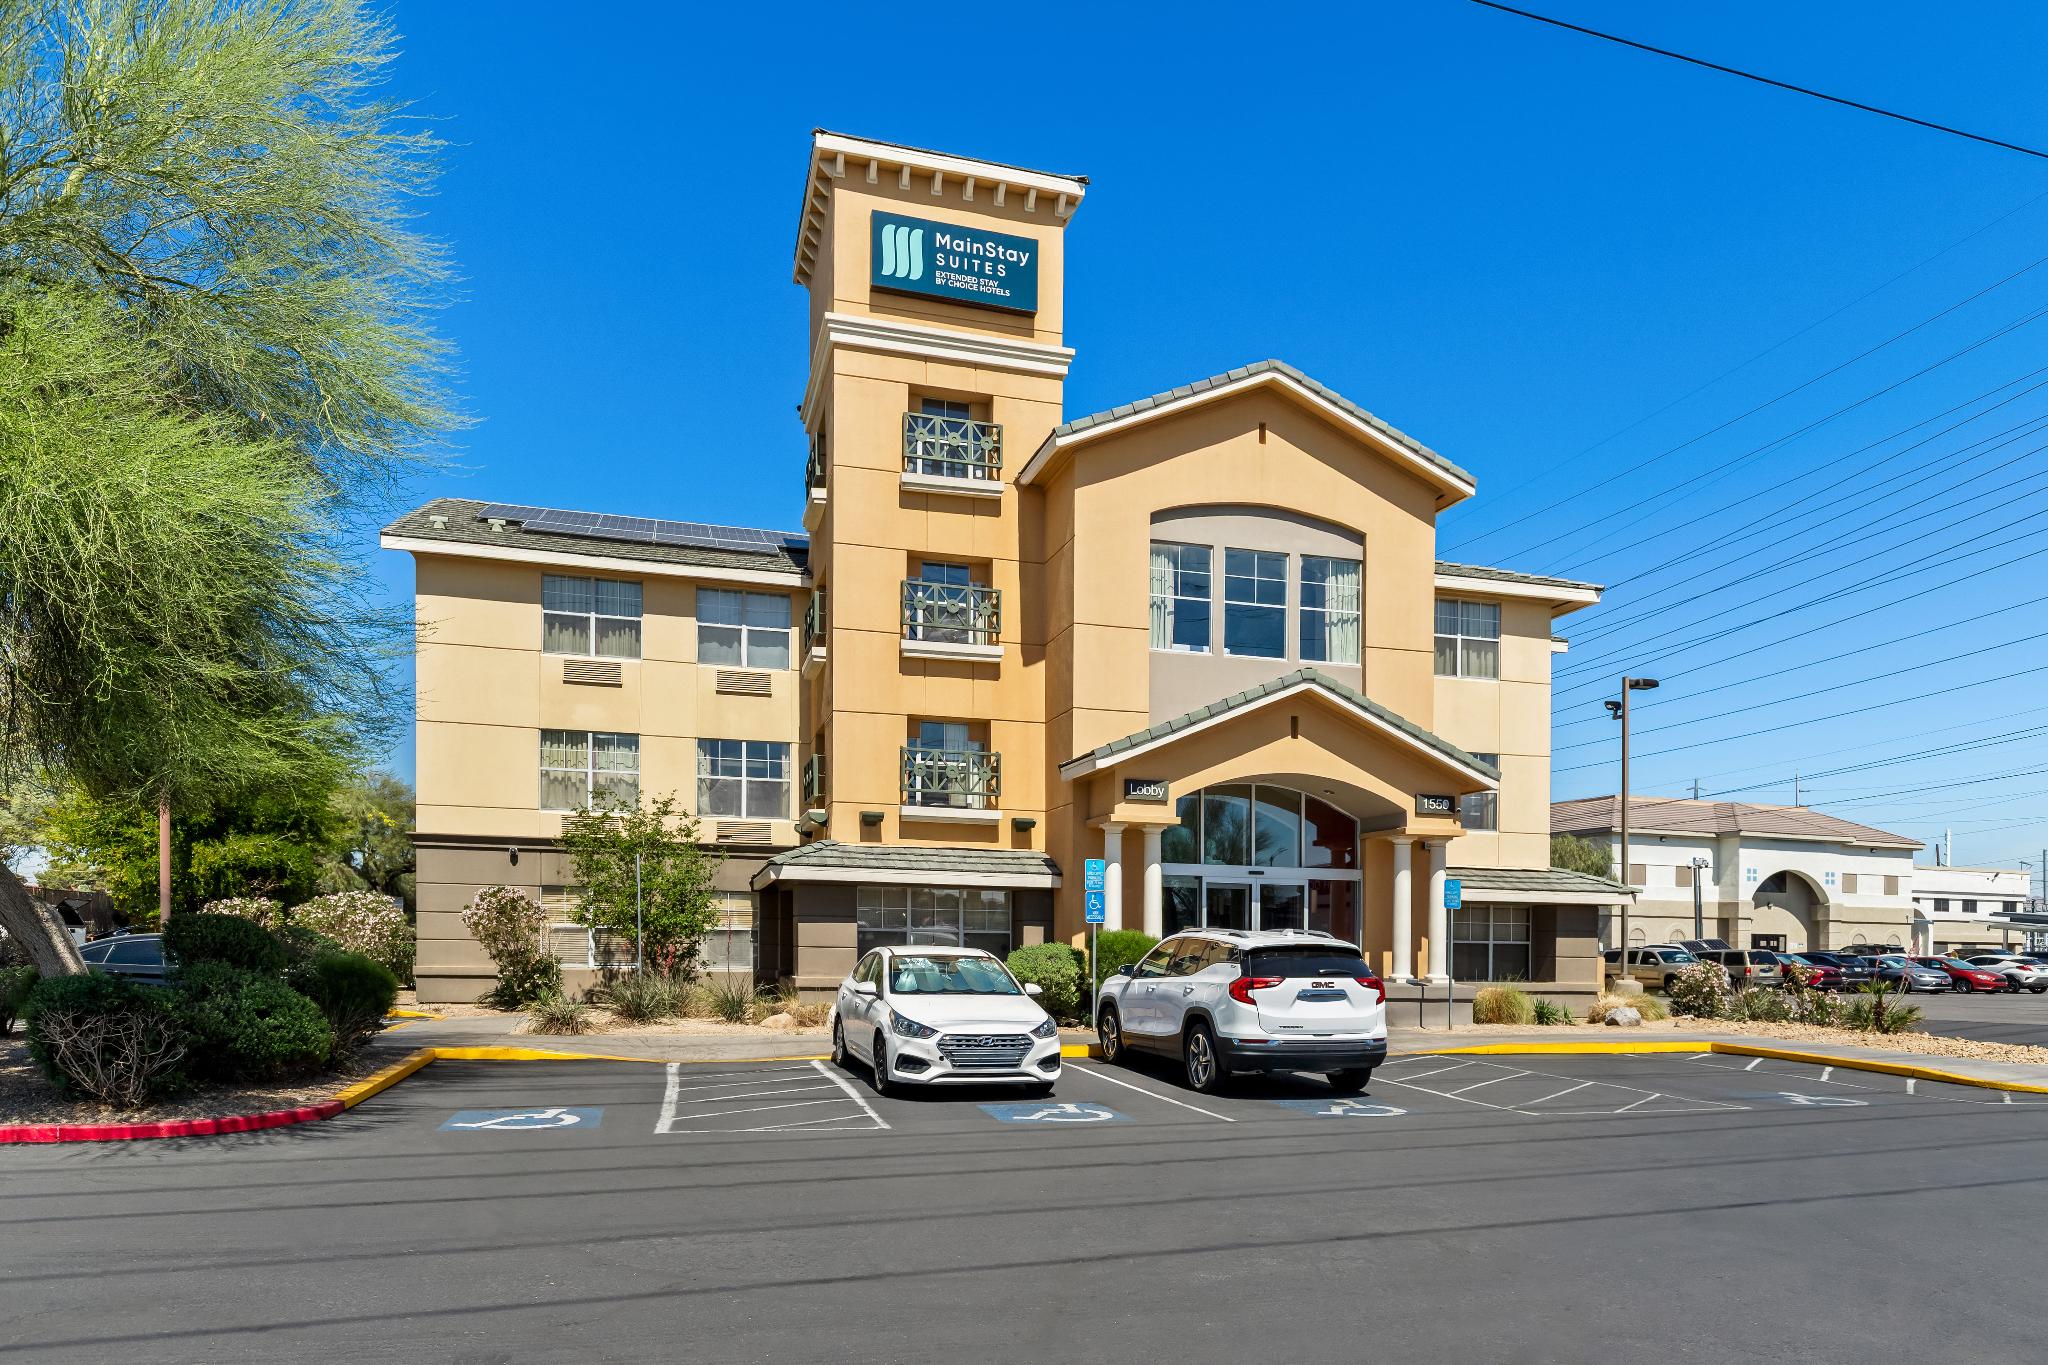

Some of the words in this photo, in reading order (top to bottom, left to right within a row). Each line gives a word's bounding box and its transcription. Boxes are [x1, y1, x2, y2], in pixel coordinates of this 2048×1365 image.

[935, 232, 1030, 267] MainStay
[936, 253, 1006, 277] SUITES
[935, 270, 978, 284] EXTENDED
[979, 278, 999, 288] STAY
[935, 277, 947, 285] BY
[948, 279, 978, 291] CHOICE
[979, 285, 1010, 297] HOTELS
[1130, 782, 1165, 798] Lobby
[1423, 798, 1450, 810] 1550
[1311, 981, 1335, 989] GMC
